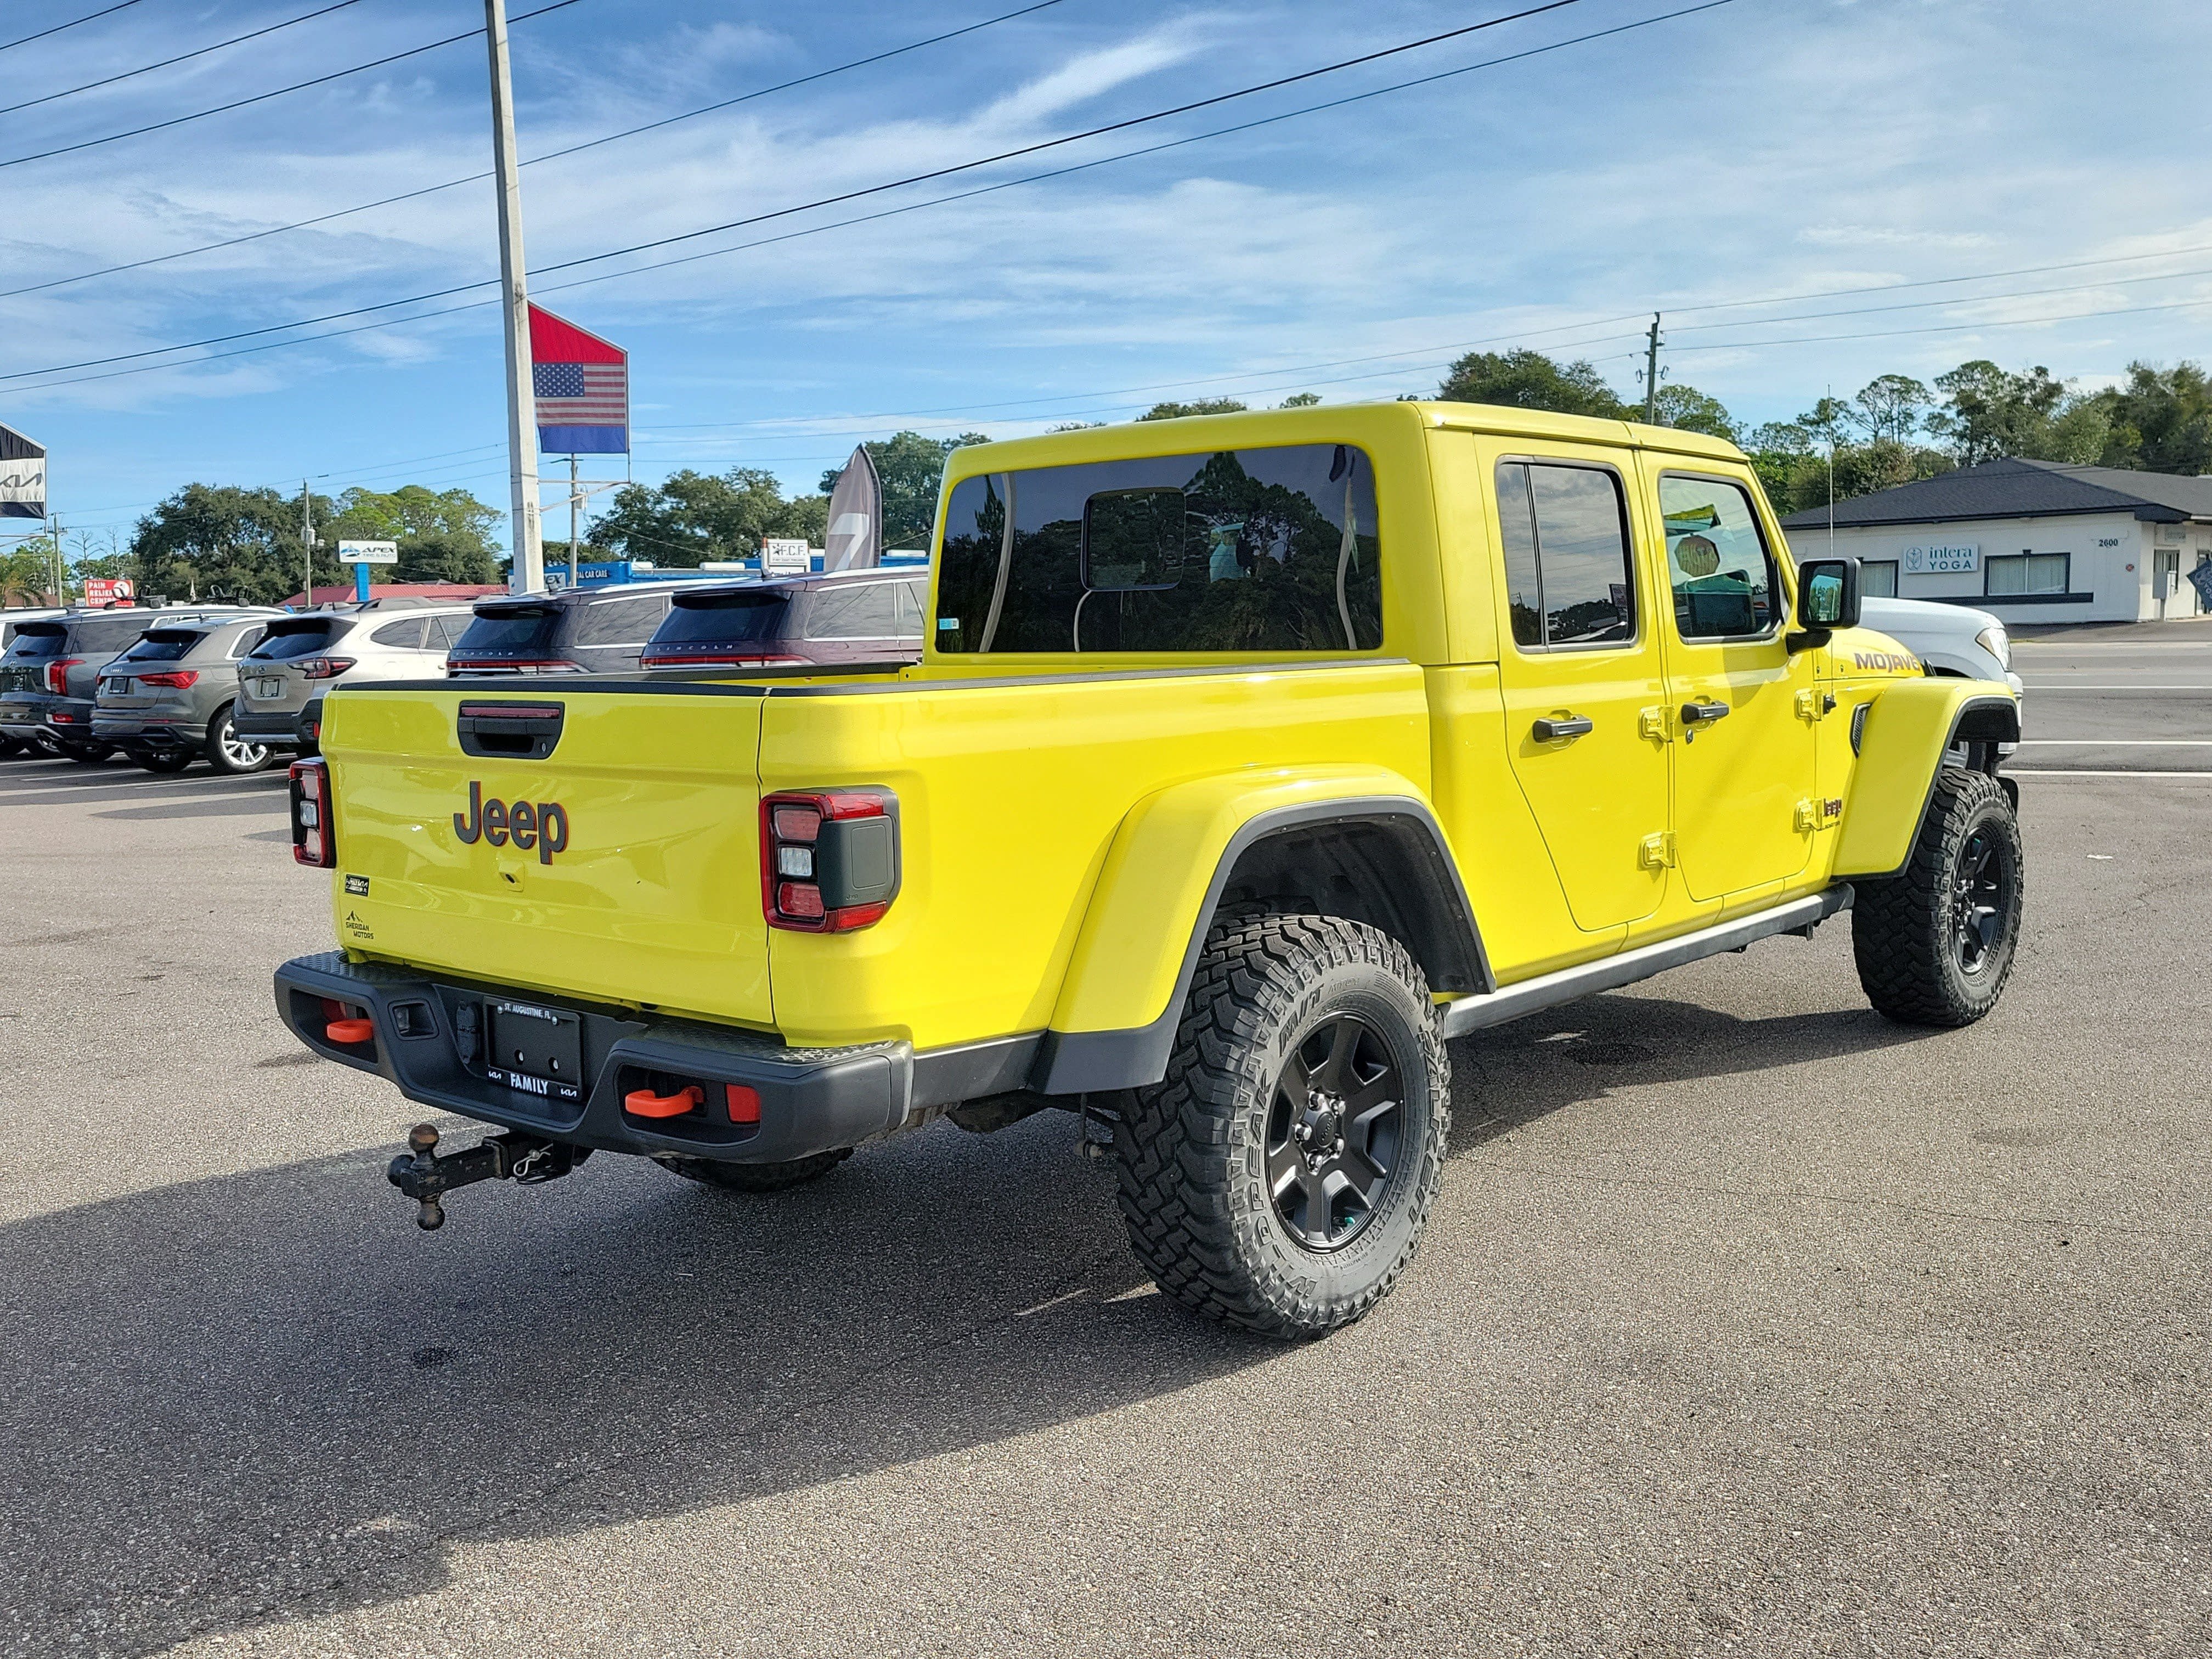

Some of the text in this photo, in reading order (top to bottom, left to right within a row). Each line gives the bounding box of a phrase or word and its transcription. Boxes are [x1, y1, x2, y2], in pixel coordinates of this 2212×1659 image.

[2098, 539, 2118, 547] 2600
[1929, 546, 1972, 558] intera
[1929, 560, 1972, 570] YOGA
[595, 569, 608, 578] CARE
[657, 644, 733, 652] LINCOLN
[1854, 652, 1920, 673] MOJAVE
[1822, 798, 1842, 818] Jeep
[453, 781, 569, 865] Jeep
[346, 922, 369, 931] SHERIDAN
[353, 930, 374, 939] MOTORS
[512, 1005, 543, 1019] AUGUSTINE,
[544, 1010, 551, 1019] FL
[510, 1073, 548, 1094] FAMILY
